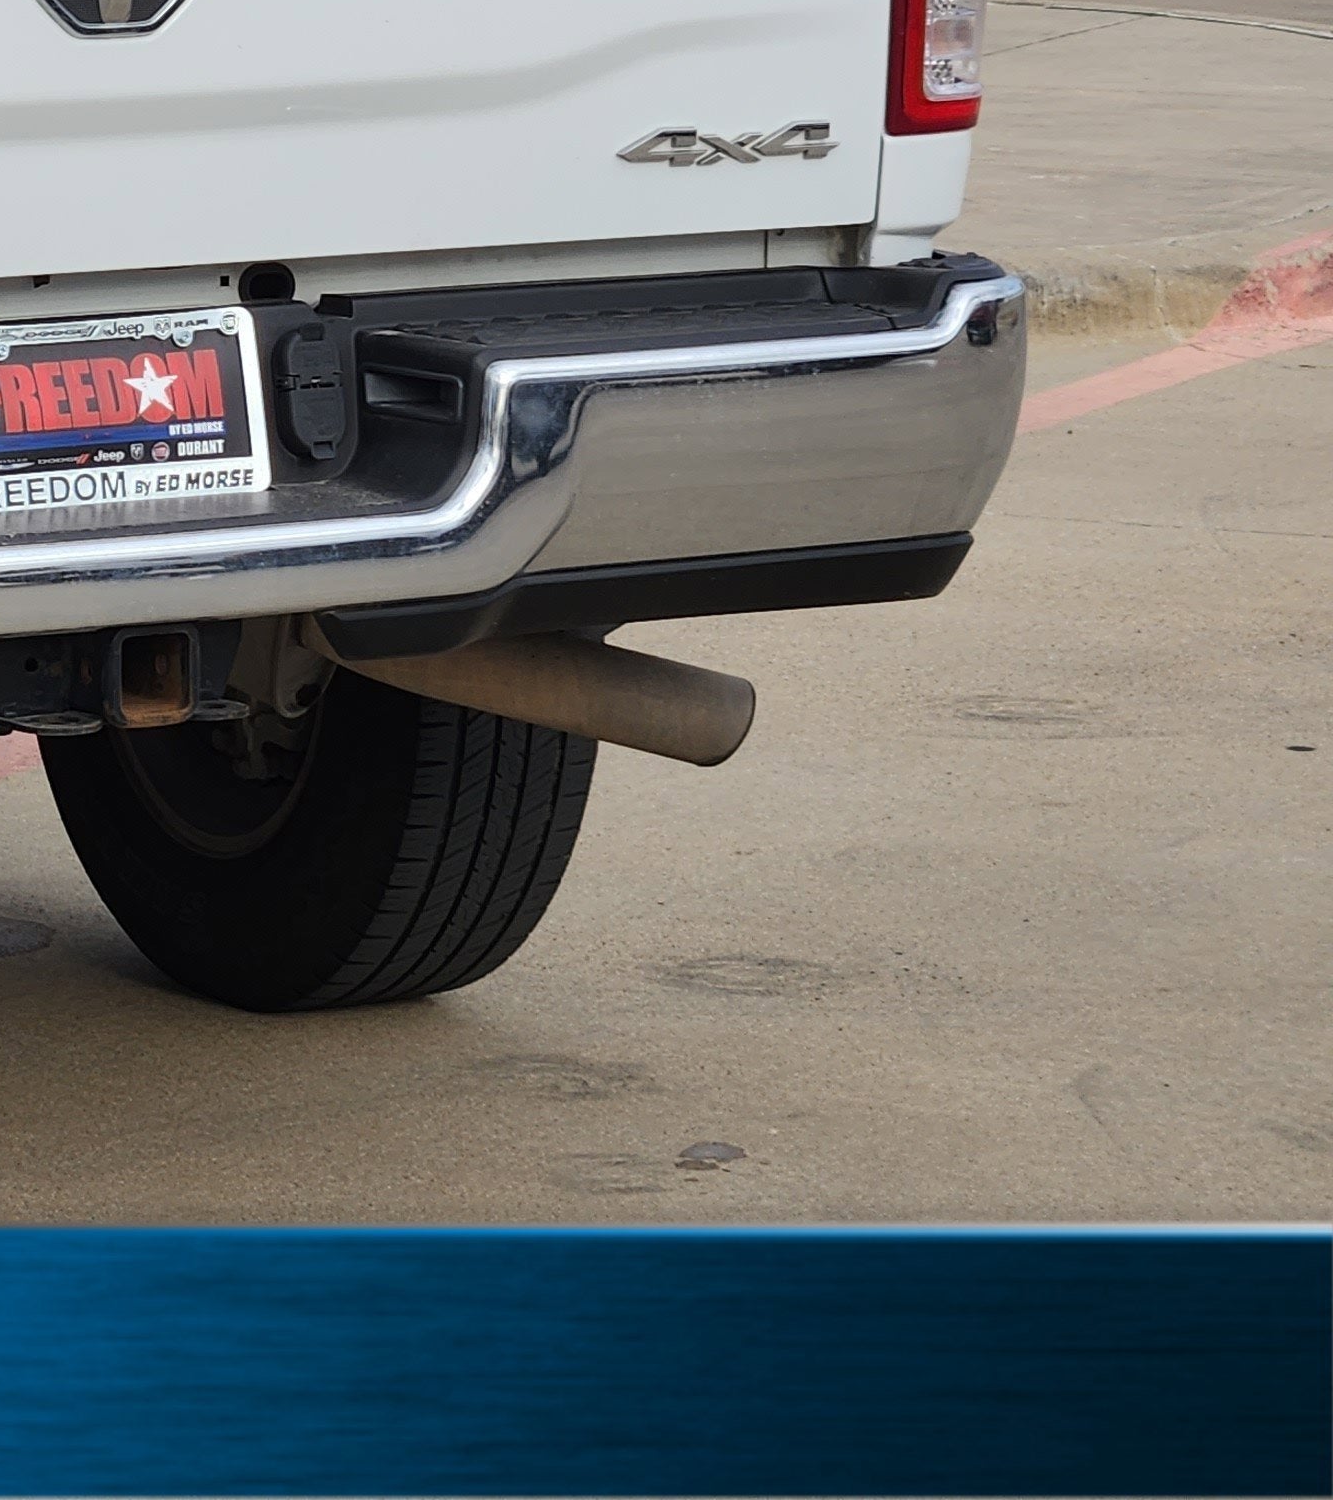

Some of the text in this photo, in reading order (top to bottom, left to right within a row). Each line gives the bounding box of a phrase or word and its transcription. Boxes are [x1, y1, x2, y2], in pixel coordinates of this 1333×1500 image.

[109, 321, 145, 337] Jeep
[173, 318, 209, 328] RAM
[94, 449, 126, 463] Jeep
[177, 439, 225, 457] DURANT
[155, 474, 181, 493] ED
[184, 468, 255, 491] MORSE
